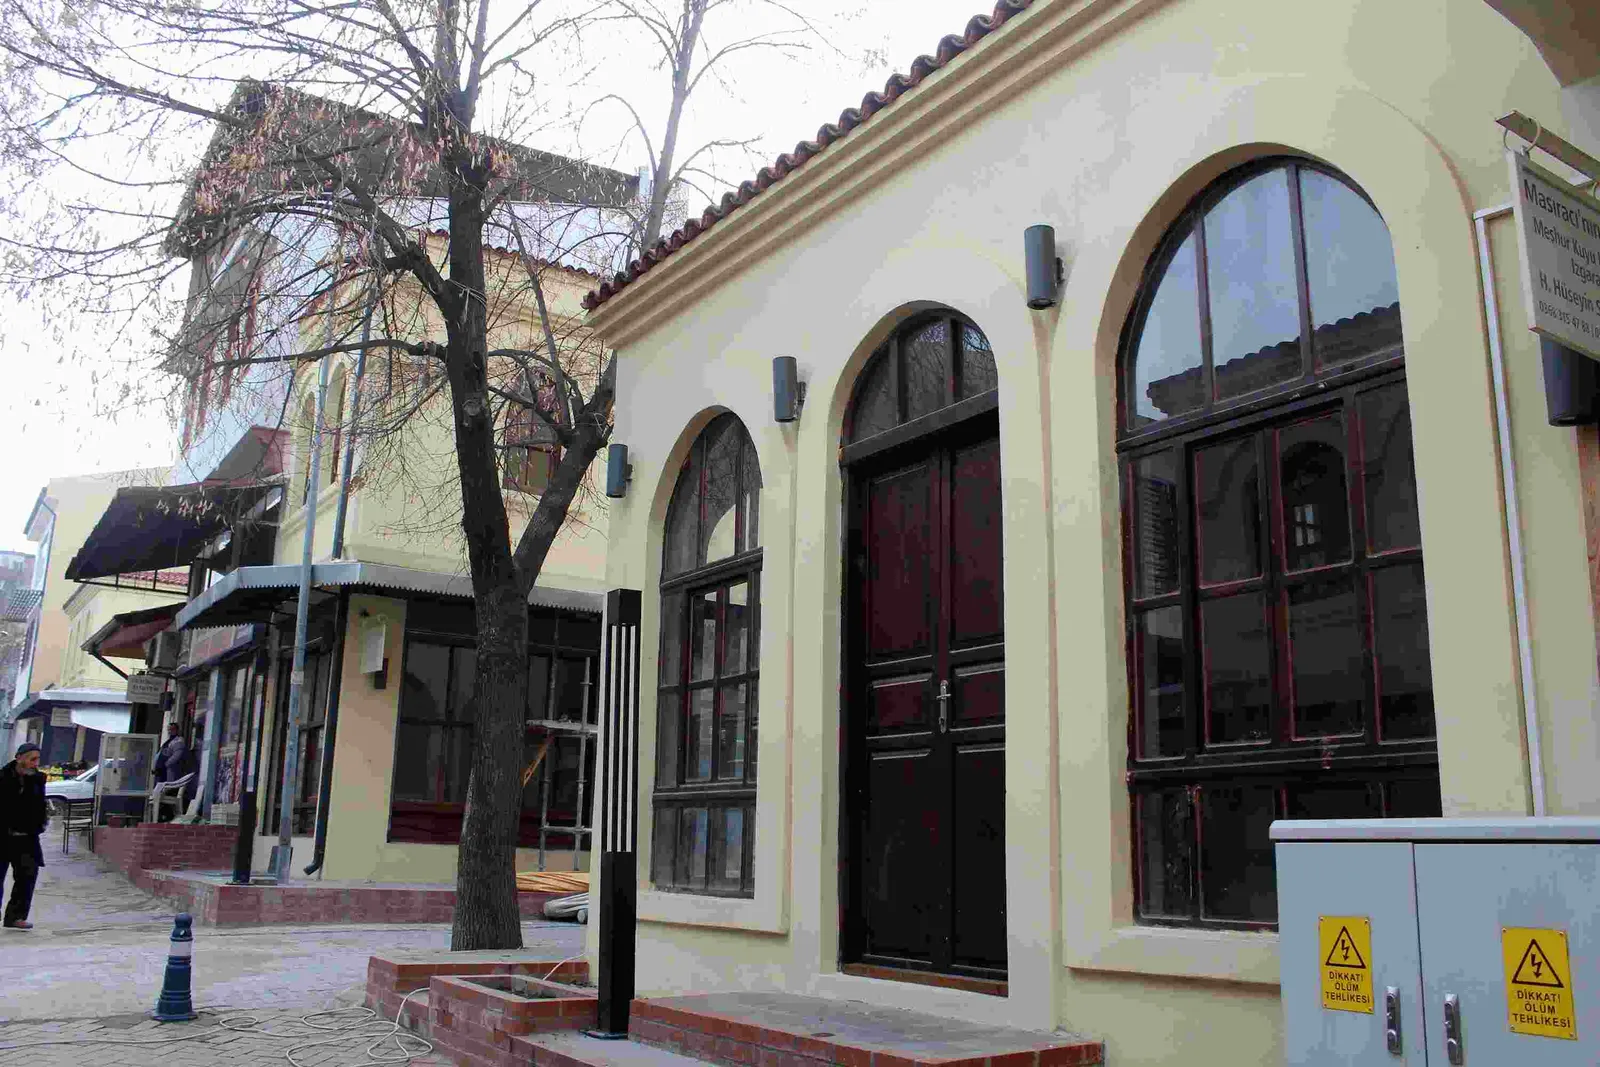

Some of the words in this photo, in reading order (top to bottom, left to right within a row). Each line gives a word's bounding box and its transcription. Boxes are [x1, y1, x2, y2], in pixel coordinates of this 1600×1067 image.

[1539, 269, 1552, 293] H.
[1334, 982, 1359, 992] ÖLÜM
[1325, 991, 1370, 1004] TEHLİKESİ
[1524, 1001, 1556, 1014] ÖLÜM
[1512, 1013, 1571, 1028] TEHLİKESİ
